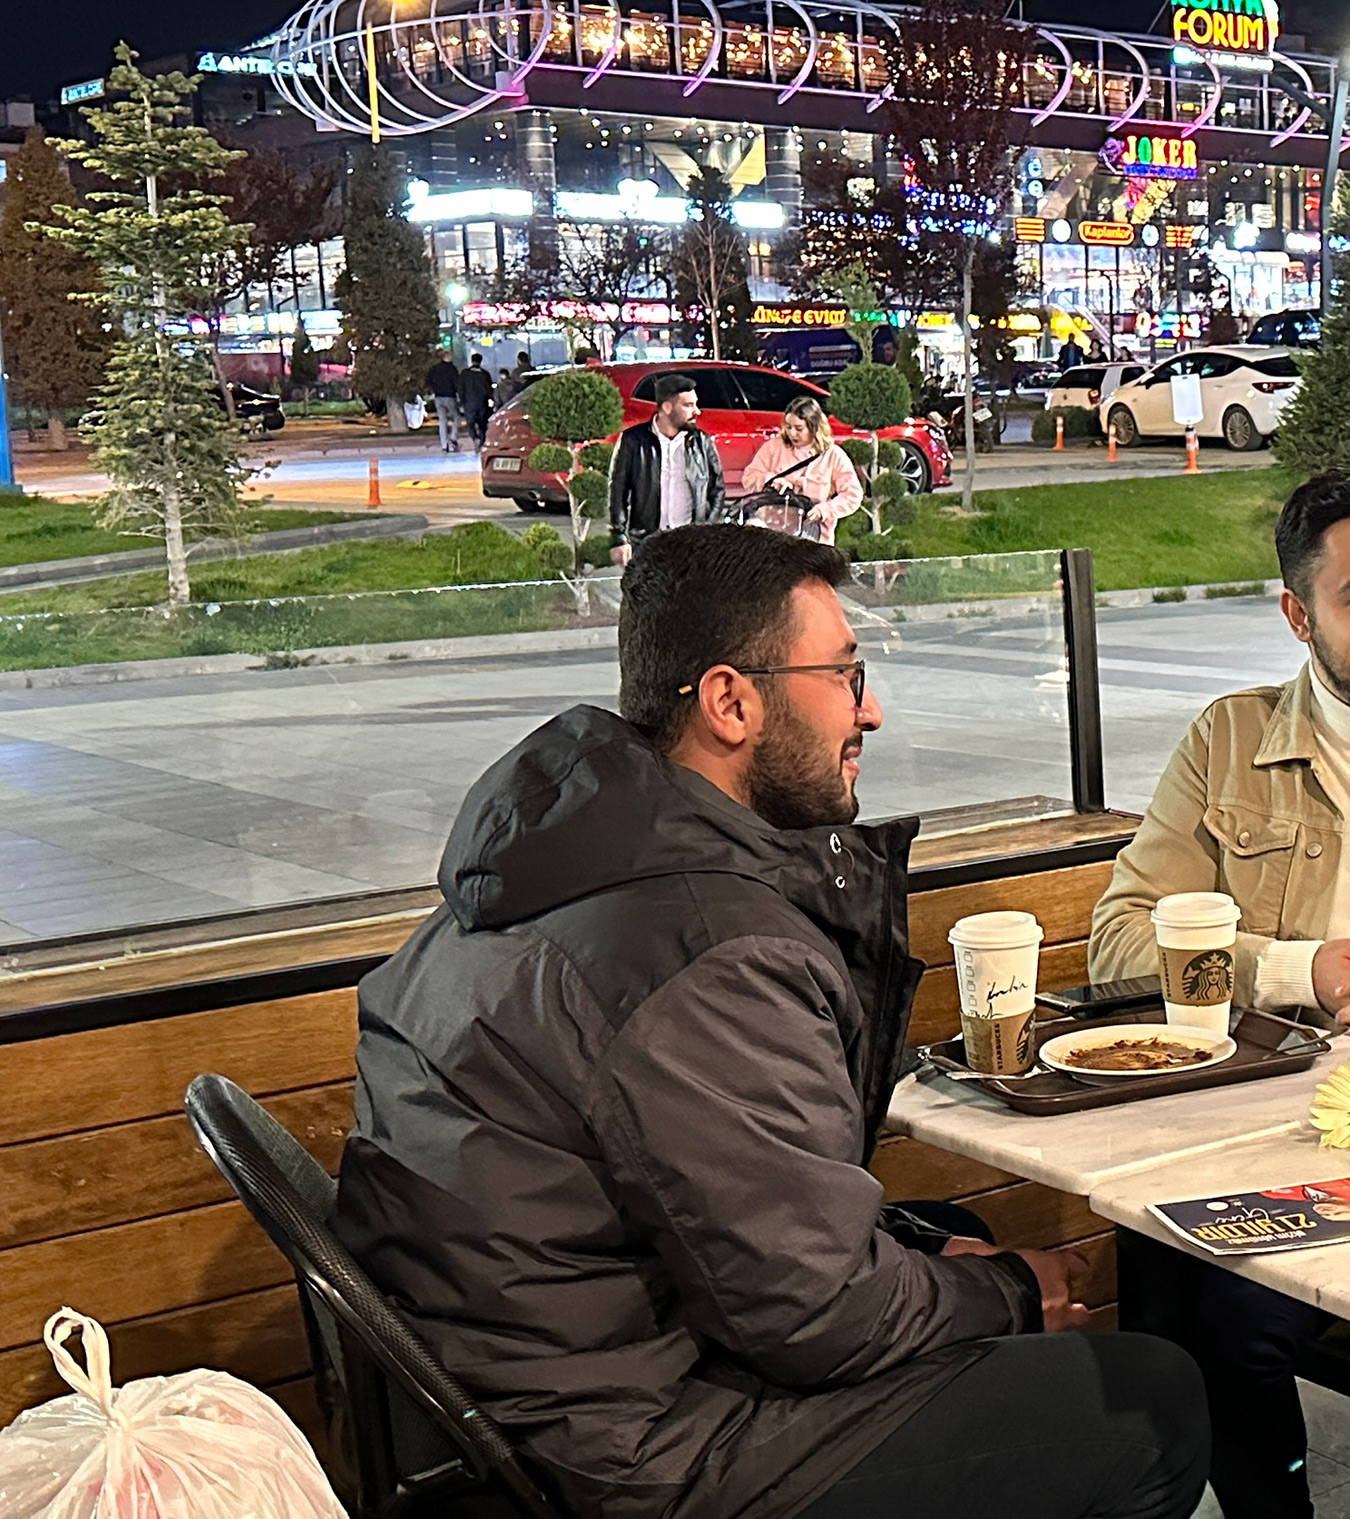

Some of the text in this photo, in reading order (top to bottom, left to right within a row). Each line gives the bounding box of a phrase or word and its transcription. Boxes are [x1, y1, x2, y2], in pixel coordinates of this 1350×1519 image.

[1173, 7, 1264, 51] FORUM
[1121, 135, 1197, 169] JOKER
[994, 1023, 1004, 1070] STARBUCKS
[1275, 1212, 1318, 1231] 21
